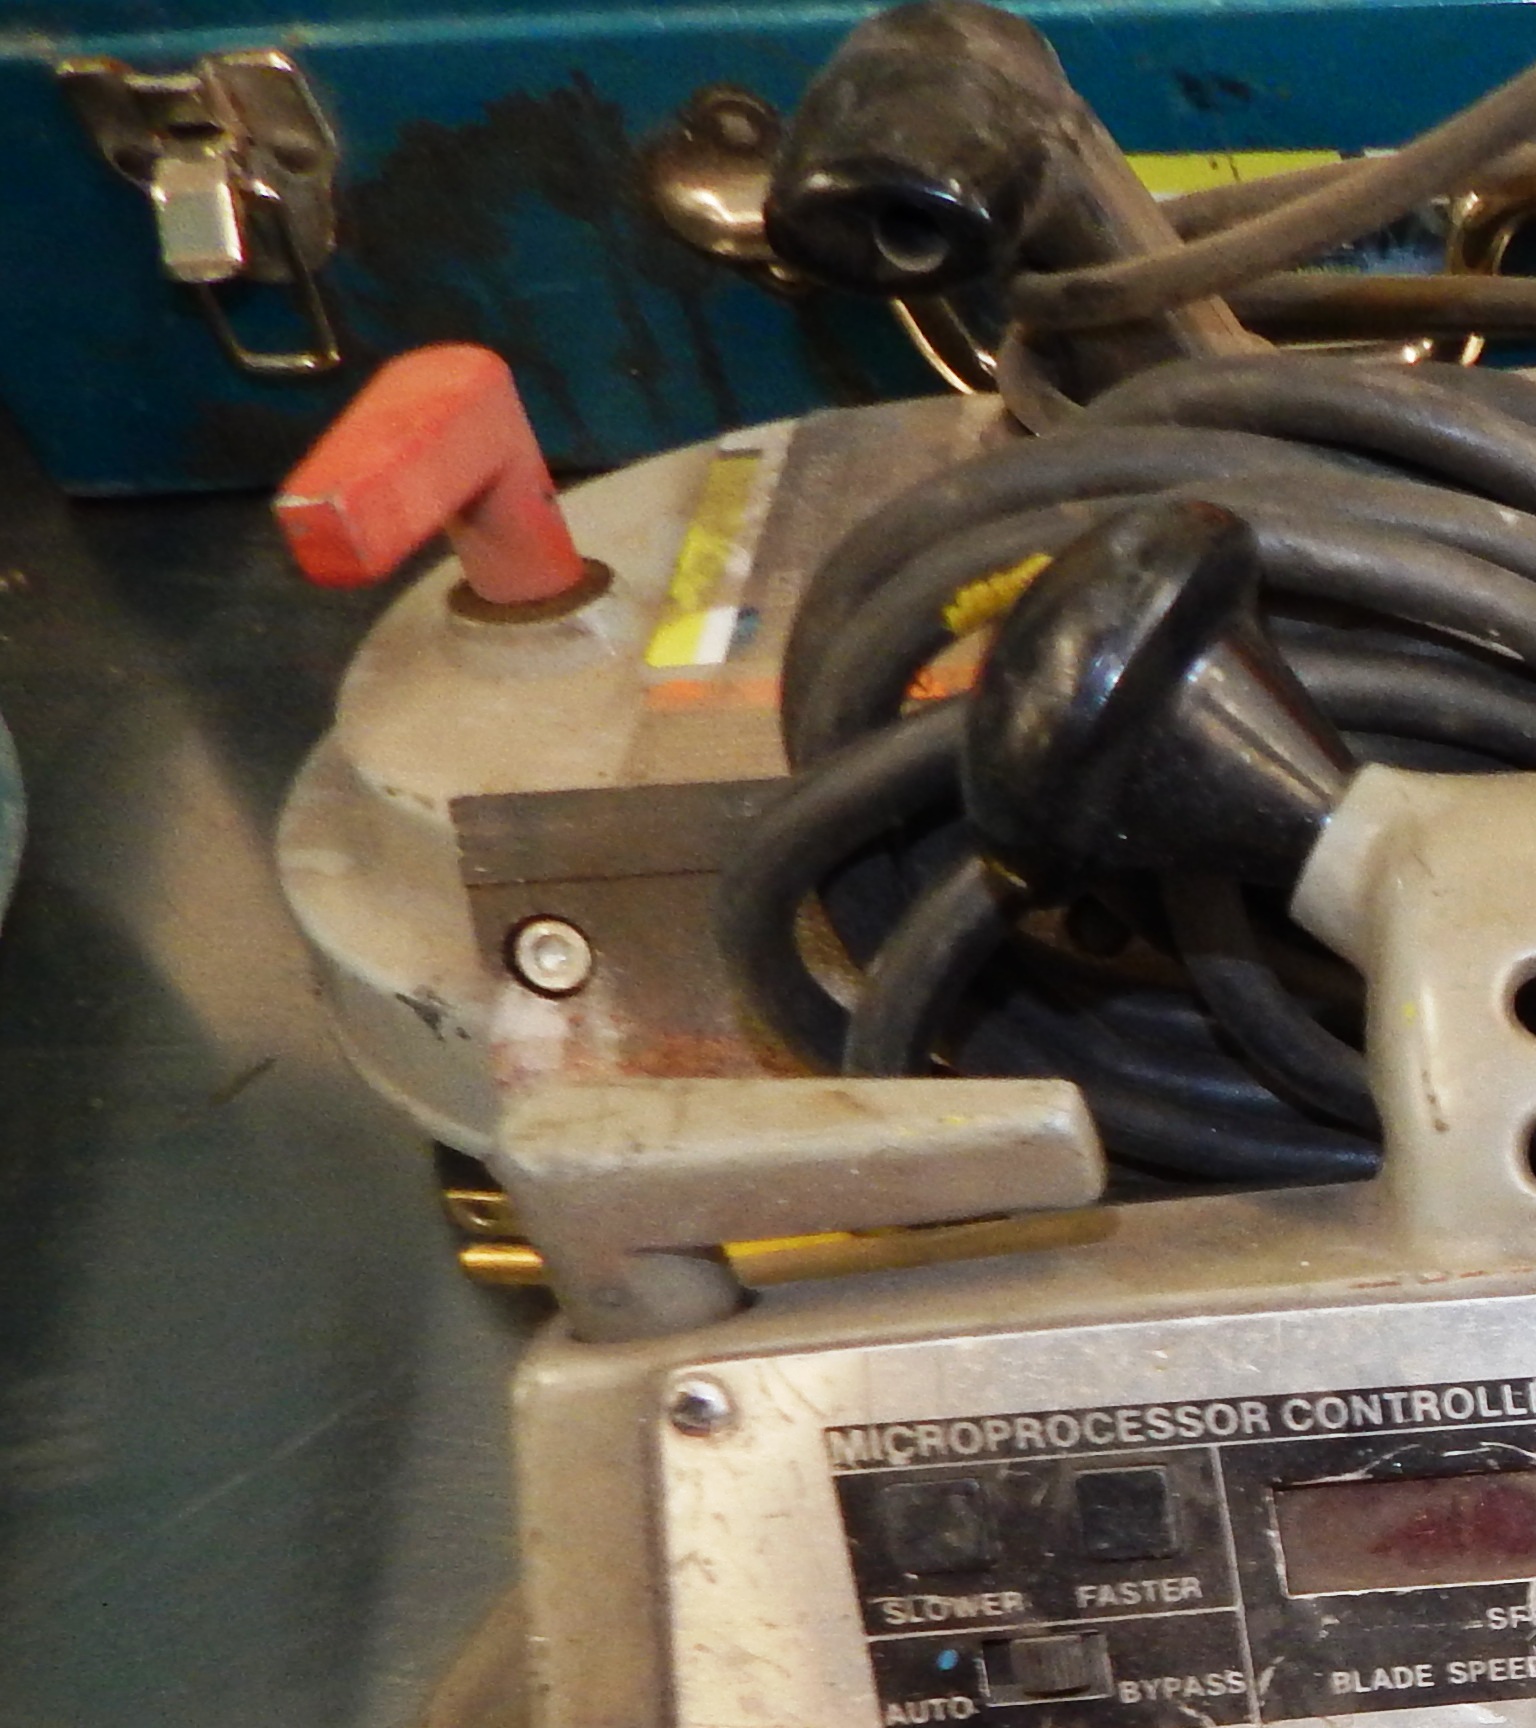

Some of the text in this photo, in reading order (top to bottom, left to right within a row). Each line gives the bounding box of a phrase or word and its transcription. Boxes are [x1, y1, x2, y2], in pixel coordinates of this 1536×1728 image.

[826, 1400, 1270, 1469] MICROPROCESSOR
[883, 1576, 1203, 1627] SLOWER FASTER
[885, 1670, 1247, 1727] AUTO BYPASS
[1330, 1661, 1435, 1695] BLADE
